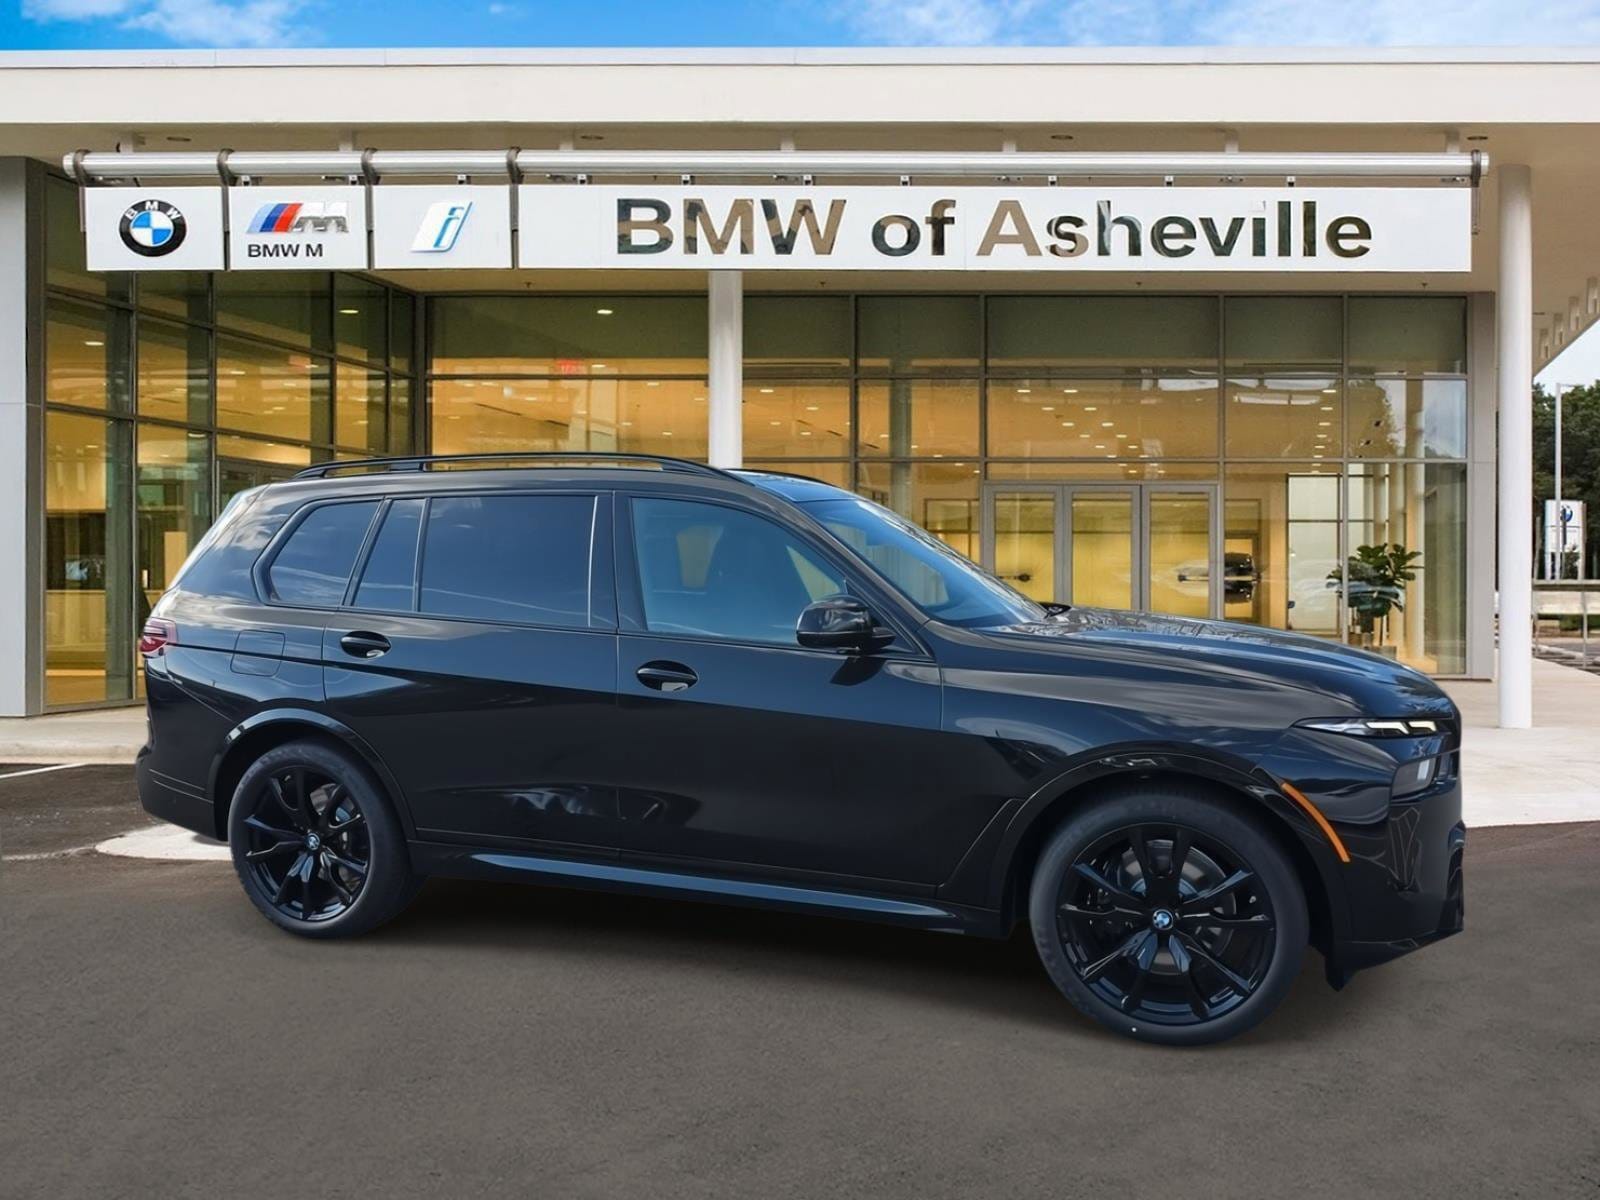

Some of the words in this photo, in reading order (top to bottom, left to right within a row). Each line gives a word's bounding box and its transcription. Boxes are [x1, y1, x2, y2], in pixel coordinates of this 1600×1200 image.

[124, 200, 182, 220] BMW
[617, 198, 847, 255] BMW
[871, 199, 956, 256] of
[976, 199, 1372, 258] Asheville
[247, 243, 300, 258] BMW
[305, 243, 323, 258] M
